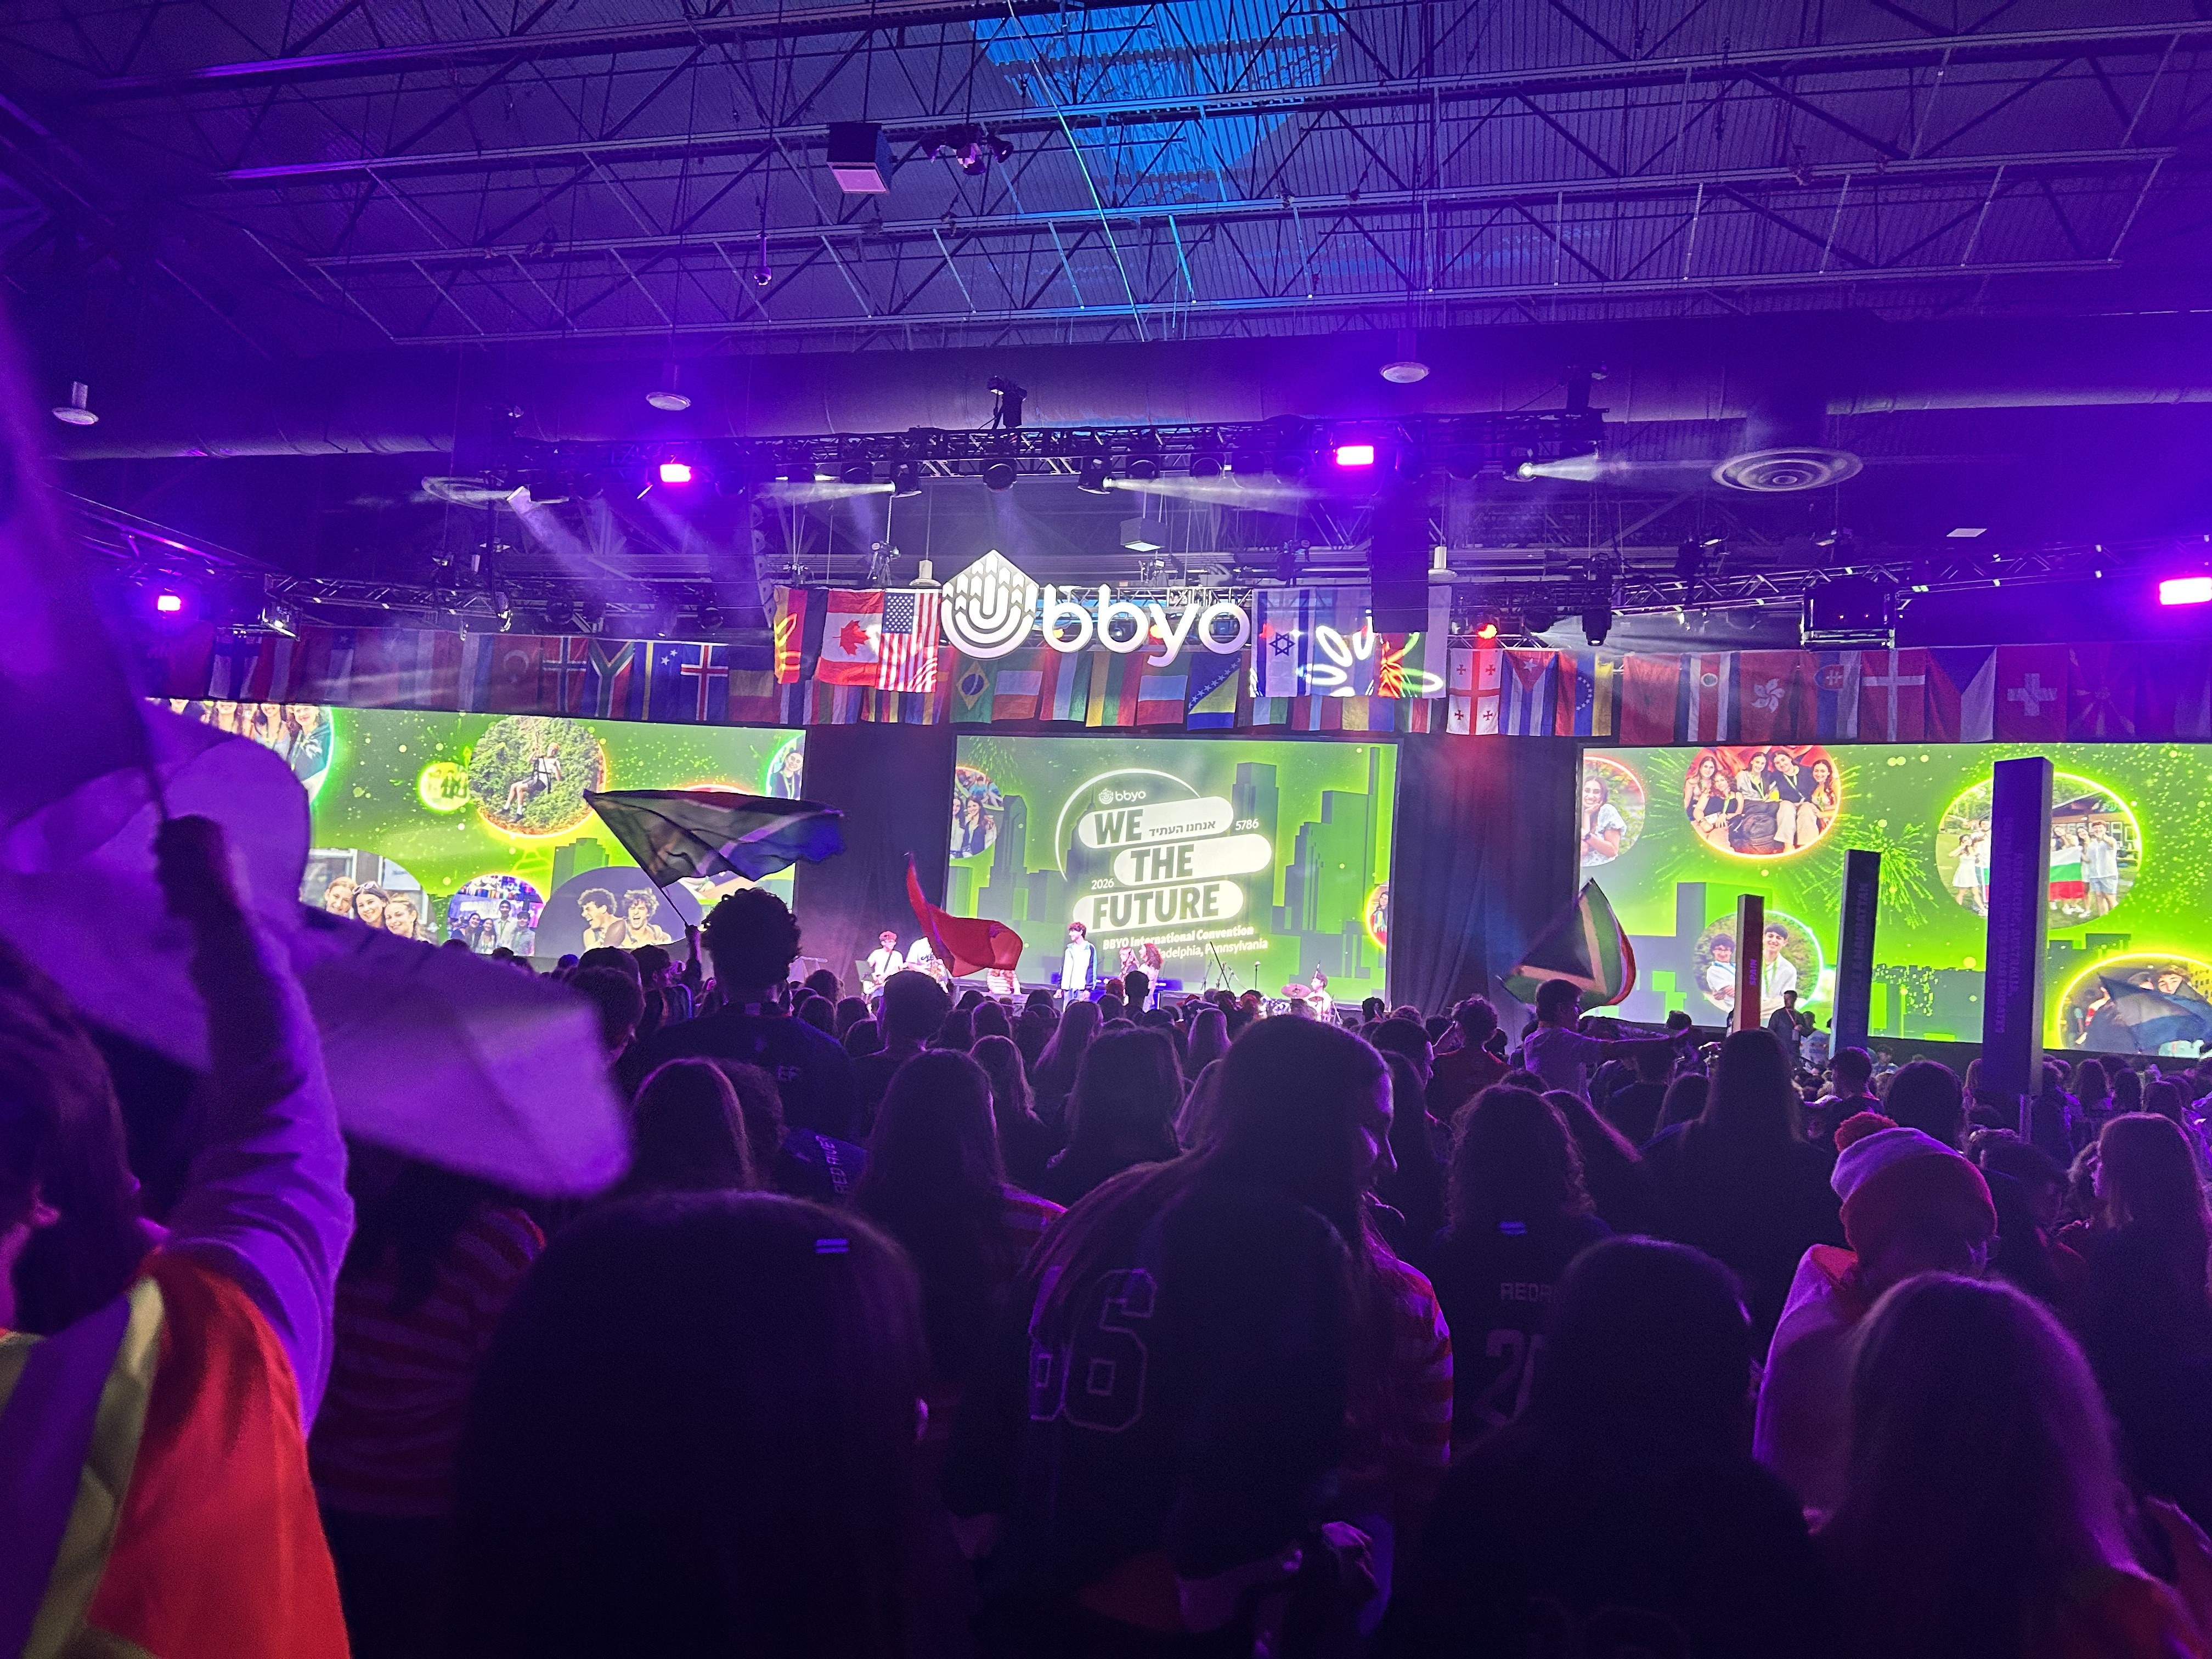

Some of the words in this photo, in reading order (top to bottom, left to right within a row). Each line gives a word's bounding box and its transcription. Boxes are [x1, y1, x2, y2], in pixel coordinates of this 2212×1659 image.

[1042, 583, 1250, 667] bbyo
[1115, 790, 1146, 802] bbyo
[1094, 809, 1143, 845] WE
[1149, 825, 1183, 837] העתיד
[1186, 821, 1216, 832] אנחנו
[1235, 819, 1259, 831] 5786
[1130, 844, 1194, 882] THE
[1091, 878, 1114, 890] 2026
[1092, 884, 1220, 929] FUTURE
[1103, 938, 1129, 950] BBYO
[1131, 930, 1195, 947] International
[1196, 924, 1254, 940] Convention
[1158, 944, 1204, 959] adelphia,
